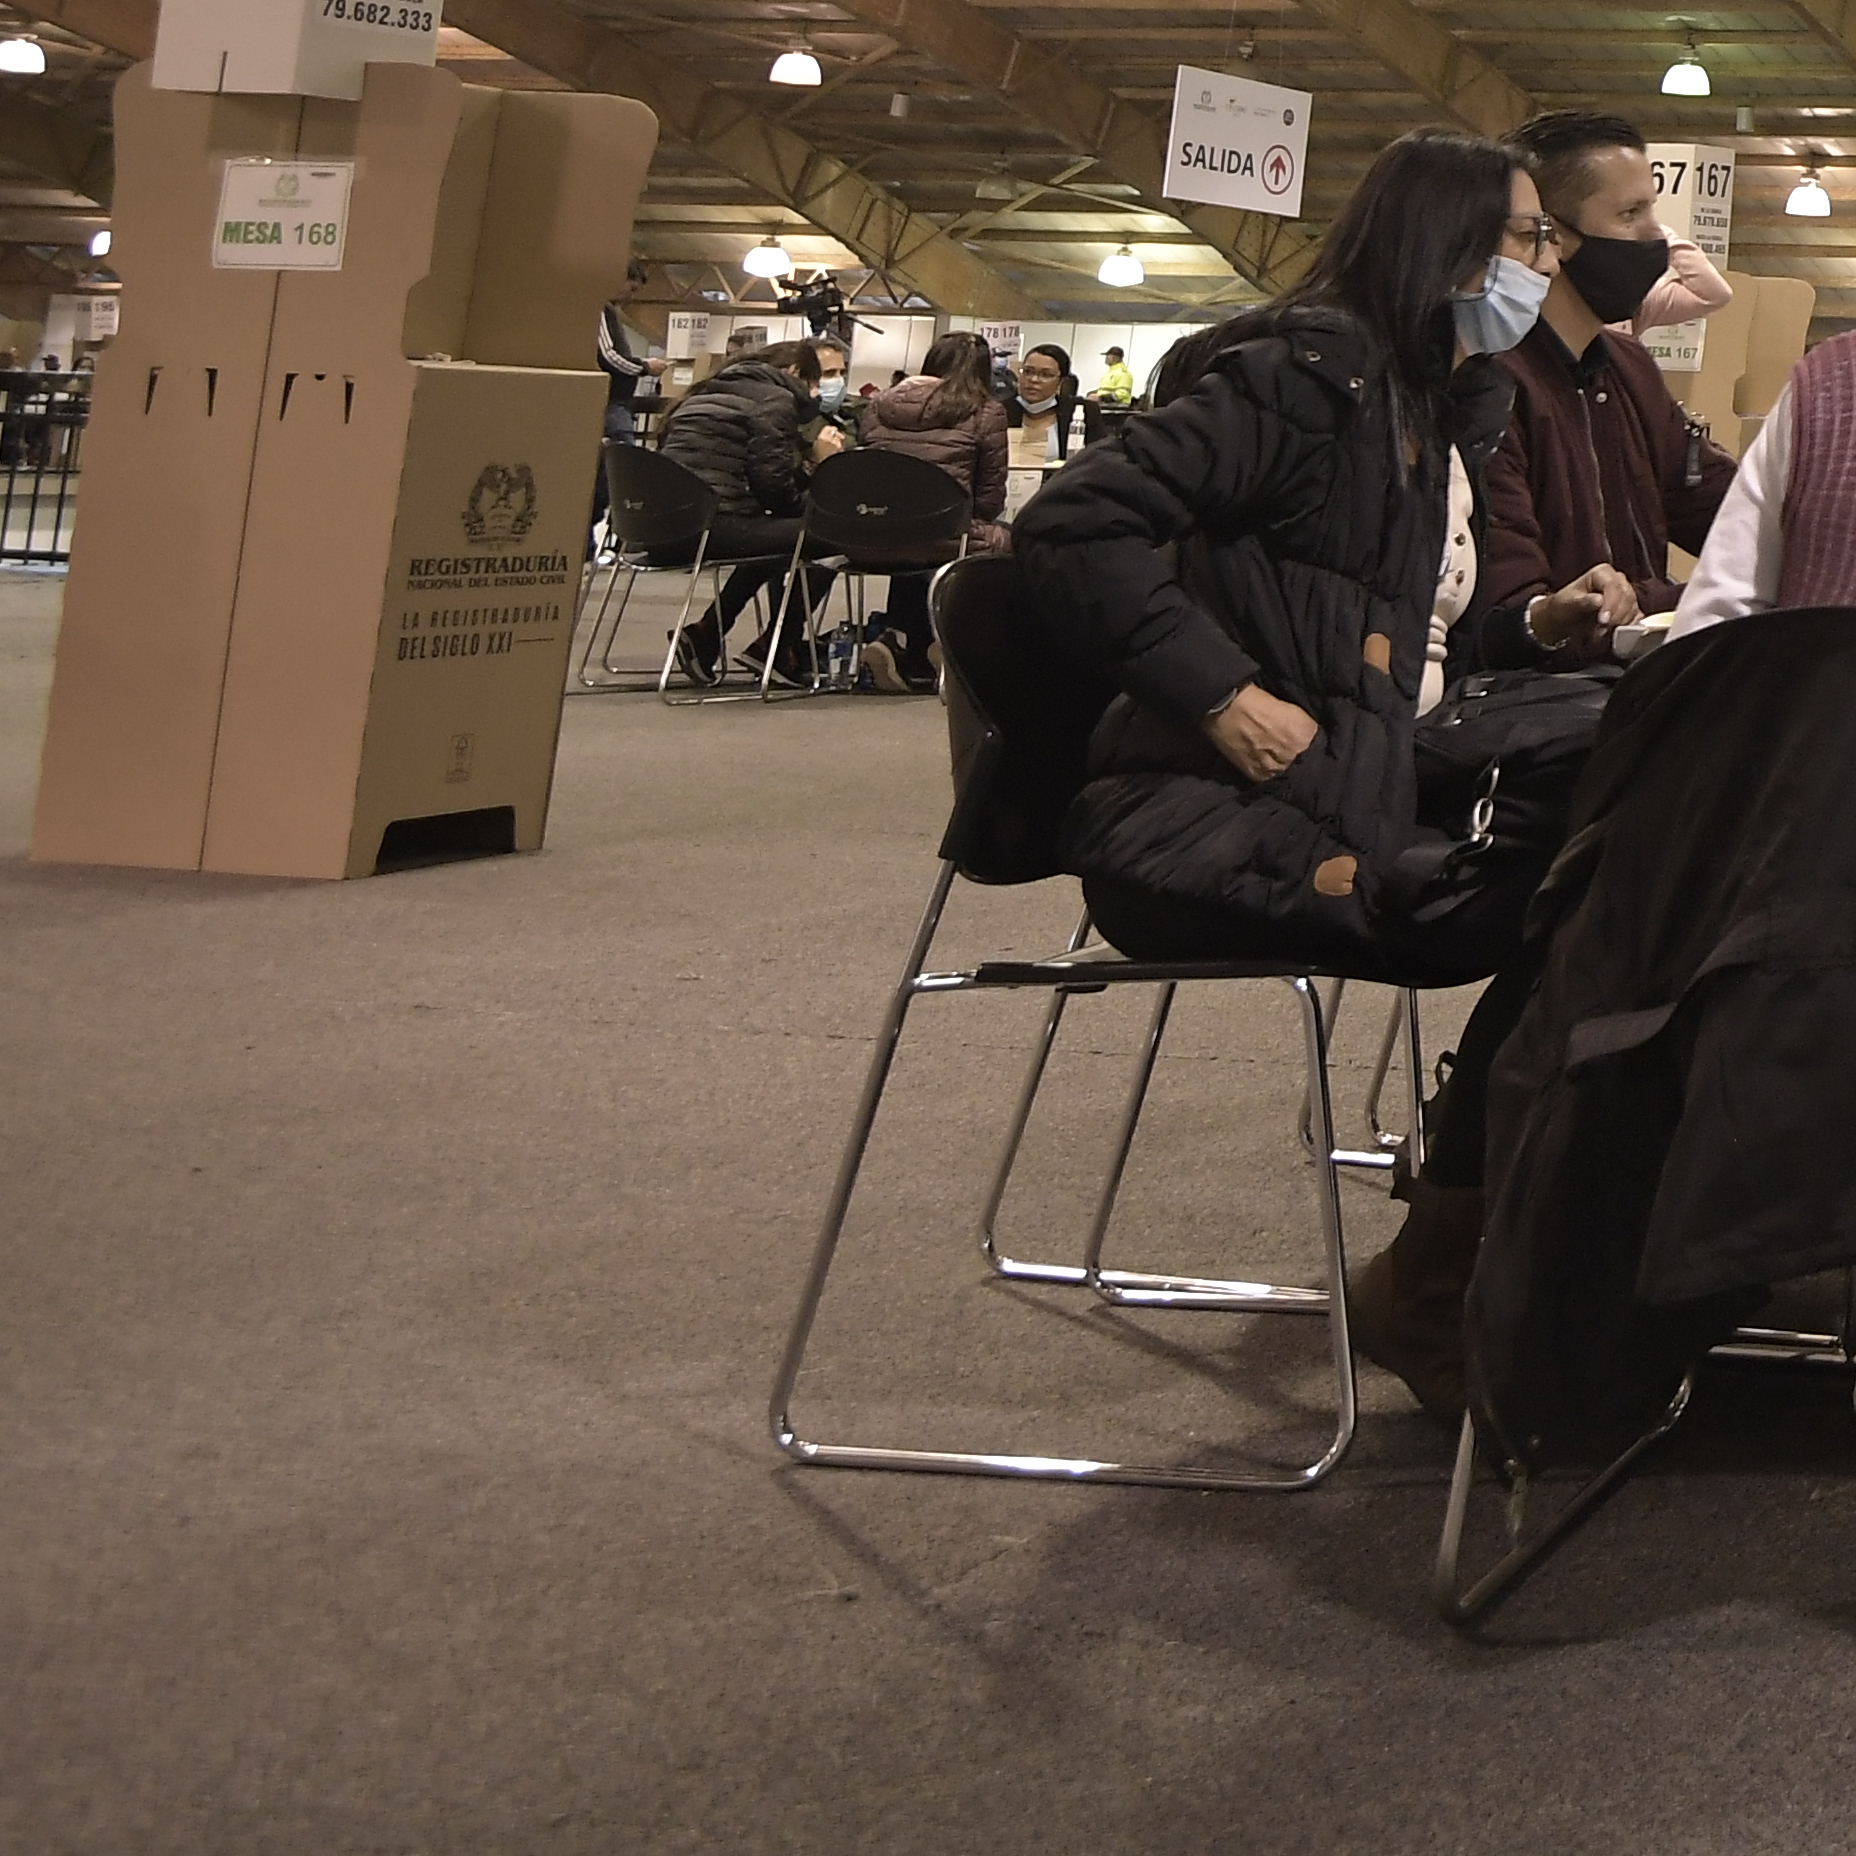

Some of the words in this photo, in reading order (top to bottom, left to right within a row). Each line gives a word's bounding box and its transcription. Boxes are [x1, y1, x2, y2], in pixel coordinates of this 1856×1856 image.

[1180, 141, 1255, 178] SALIDA
[1651, 160, 1688, 195] 67
[1695, 161, 1732, 199] 167
[221, 220, 283, 245] MESA
[294, 222, 338, 246] 168
[981, 327, 1000, 339] 178
[1676, 346, 1699, 359] 167
[408, 548, 569, 577] REGISTRADURÍA
[407, 577, 464, 590] NACIONAL
[468, 576, 491, 588] DEL
[494, 574, 537, 587] ESTADO
[539, 573, 567, 585] CIVIL
[402, 611, 420, 631] LA
[430, 601, 560, 628] REGISTRADURÍA
[398, 636, 427, 661] DEL
[431, 632, 481, 659] SIGLO
[486, 631, 514, 655] XXI
